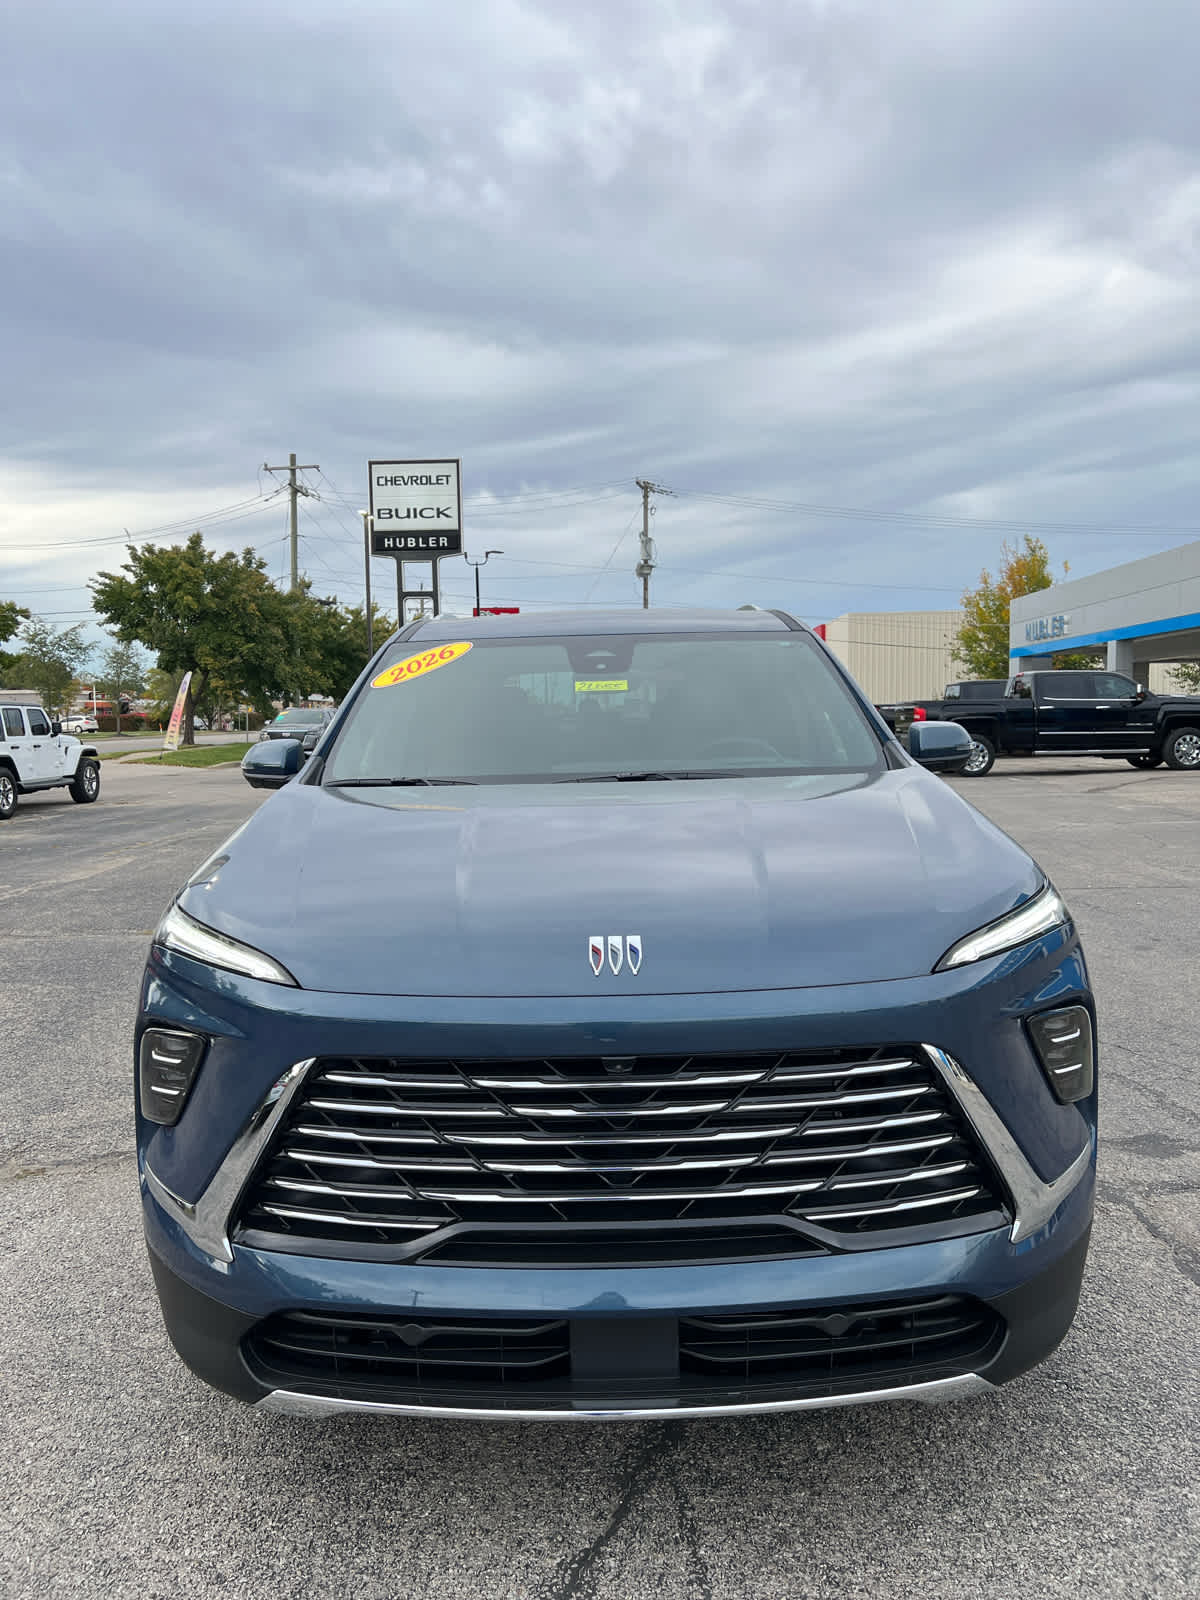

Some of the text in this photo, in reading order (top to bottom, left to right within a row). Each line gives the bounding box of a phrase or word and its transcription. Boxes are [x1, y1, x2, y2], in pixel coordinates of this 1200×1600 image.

[376, 474, 452, 487] CHEVROLET
[376, 506, 453, 520] BUICK
[384, 536, 449, 548] HUBLER
[390, 645, 455, 682] 2026
